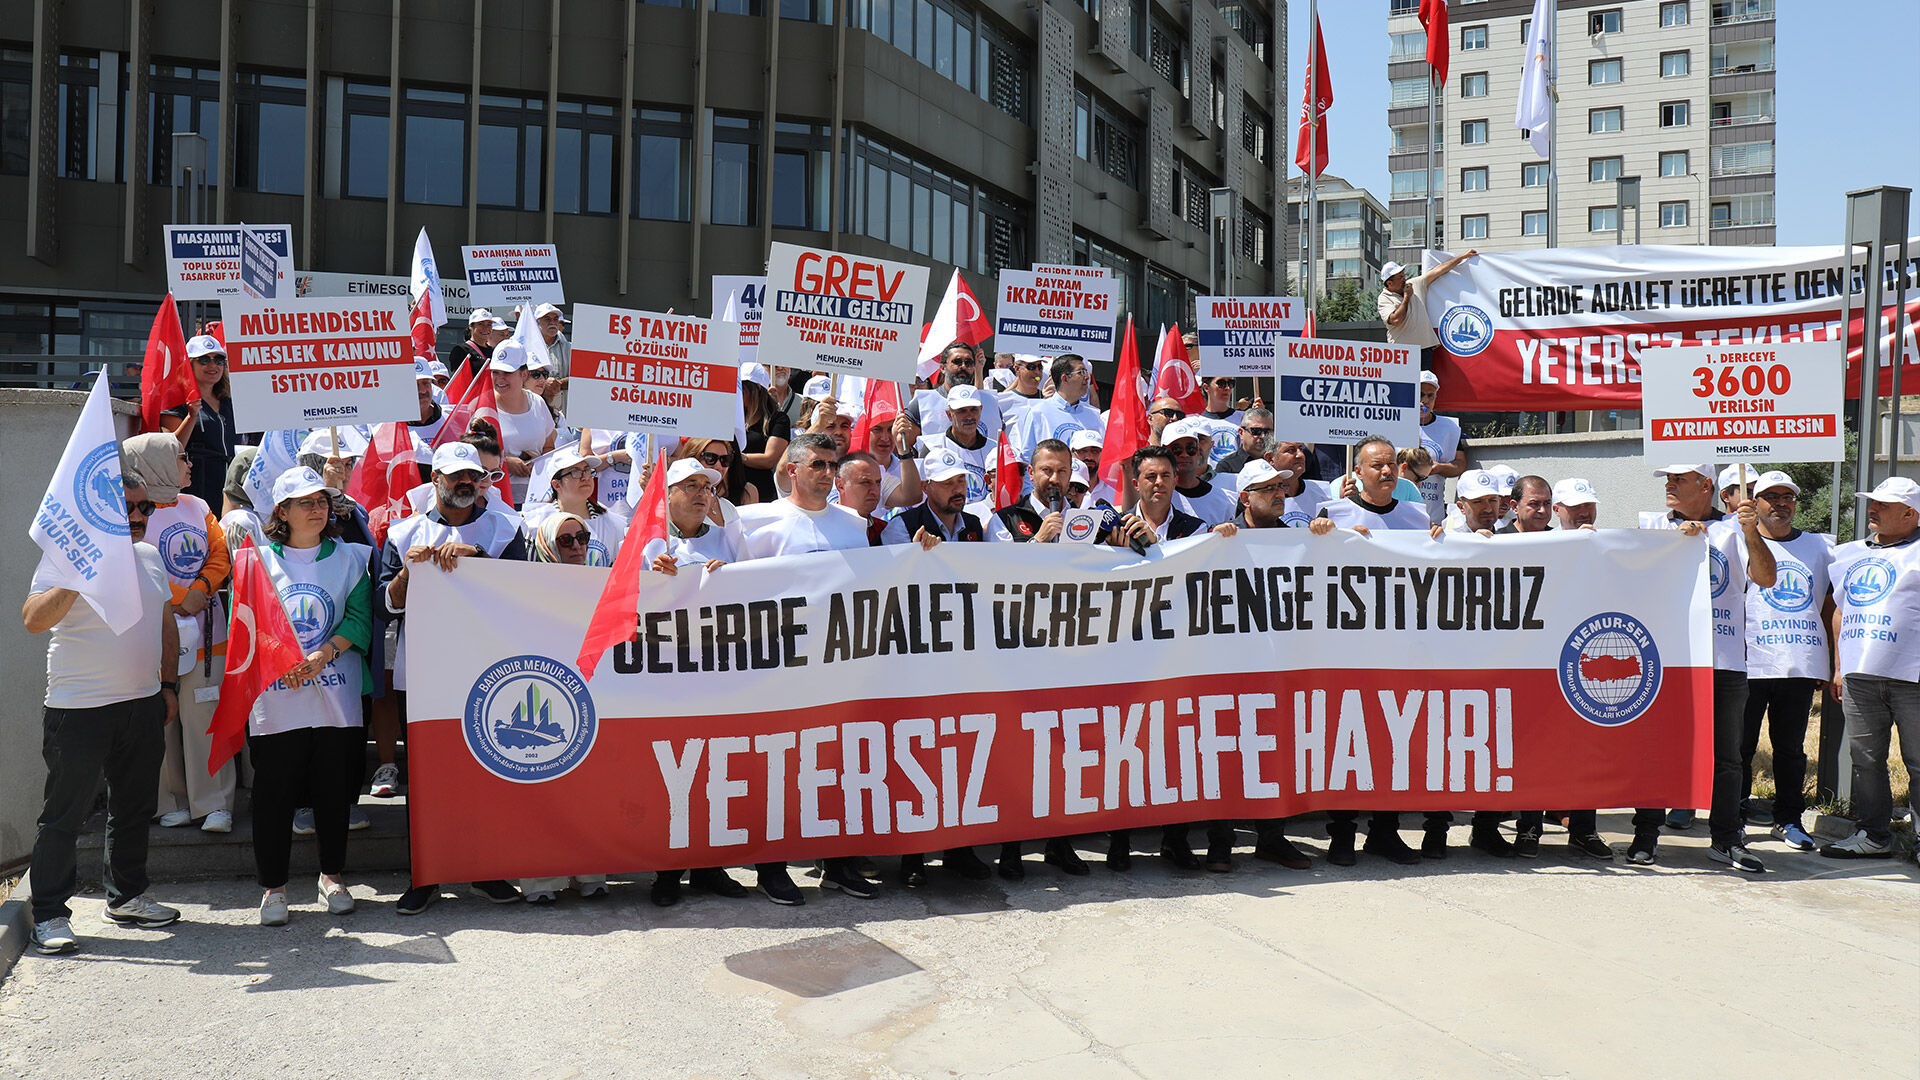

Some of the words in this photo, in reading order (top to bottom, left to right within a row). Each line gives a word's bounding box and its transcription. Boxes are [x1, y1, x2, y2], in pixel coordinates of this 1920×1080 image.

[176, 233, 231, 244] MASANIN
[202, 245, 241, 256] TANIN
[472, 249, 522, 259] DAYANIŞMA
[524, 247, 551, 257] AİDATI
[183, 262, 213, 271] TOPLU
[473, 268, 517, 283] EMEĞİN
[521, 270, 554, 281] HAKKI
[180, 272, 227, 281] TASARRUF
[794, 251, 905, 302] GREV
[1035, 277, 1082, 290] BAYRAM
[501, 284, 531, 292] VERİLSİN
[1006, 285, 1108, 310] İKRAMİYESİ
[1499, 284, 1583, 318] GELİRDE
[1591, 279, 1673, 314] ADALET
[1681, 272, 1786, 308] ÜCRETTE
[1794, 264, 1867, 300] DENG
[779, 292, 841, 316] HAKKI
[847, 299, 910, 323] GELSİN
[1039, 308, 1073, 320] GELSİN
[1211, 298, 1291, 319] MÜLAKAT
[240, 308, 396, 336] MÜHENDİSLİK
[609, 314, 631, 339] EŞ
[639, 317, 707, 345] TAYİNİ
[786, 315, 846, 334] SENDİKAL
[850, 325, 898, 342] HAKLAR
[1003, 323, 1038, 334] MEMUR
[1040, 326, 1078, 338] BAYRAM
[1081, 329, 1108, 340] ETSİN!
[1225, 319, 1280, 329] KALDIRILSIN
[625, 339, 688, 359] ÇÖZÜLSÜN
[800, 330, 826, 345] TAM
[830, 335, 883, 352] VERİLSİN
[1039, 343, 1072, 351] MEMUR-SEN
[241, 344, 318, 365] MESLEK
[323, 341, 401, 361] KANUNU
[816, 353, 863, 366] MEMUR-SEN
[1223, 348, 1246, 358] ESAS
[1249, 348, 1275, 358] ALINS
[1288, 342, 1356, 362] KAMUDA
[1360, 347, 1409, 366] ŞİDDET
[1706, 354, 1717, 363] 1.
[1720, 351, 1776, 363] DERECEYE
[595, 356, 635, 381] AİLE
[642, 360, 709, 389] BİRLİĞİ
[1319, 364, 1340, 376] SON
[1343, 365, 1382, 378] BULSUN
[1692, 363, 1791, 398] 3600
[271, 369, 379, 393] İSTİYORUZ!
[610, 385, 692, 409] SAĞLANSIN
[1300, 378, 1391, 405] CEZALAR
[303, 406, 358, 416] MEMUR-SEN
[1299, 403, 1360, 420] CAYDIRICI
[1363, 407, 1401, 421] OLSUN
[1708, 398, 1775, 414] VERİLSİN
[628, 413, 678, 425] MEMUR-SEN
[1661, 420, 1718, 437] AYRIM
[1723, 419, 1770, 436] SONA
[1774, 416, 1825, 434] ERSİN
[1328, 428, 1368, 437] MEMUR-SEN
[1716, 445, 1770, 453] MEMUR-SEN
[37, 509, 98, 581] MUR-SEN
[823, 583, 978, 664] ADALET
[993, 576, 1175, 650] ÜCRETTE
[1186, 566, 1314, 637] DENGE
[1326, 565, 1545, 632] İSTİYORUZ
[1570, 617, 1650, 651] MEMUR-SEN
[1762, 619, 1817, 631] BAYINDIR
[1756, 634, 1822, 646] MEMUR-SEN
[478, 661, 522, 693] BAYINDIR
[524, 660, 583, 695] MEMUR-SEN
[1566, 661, 1577, 693] MEMUR
[1615, 660, 1655, 718] KONFEDERASYONU
[651, 713, 999, 850] YETERSİZ
[1021, 692, 1280, 819] TEKLİFE
[1294, 687, 1514, 794] HAYIR!
